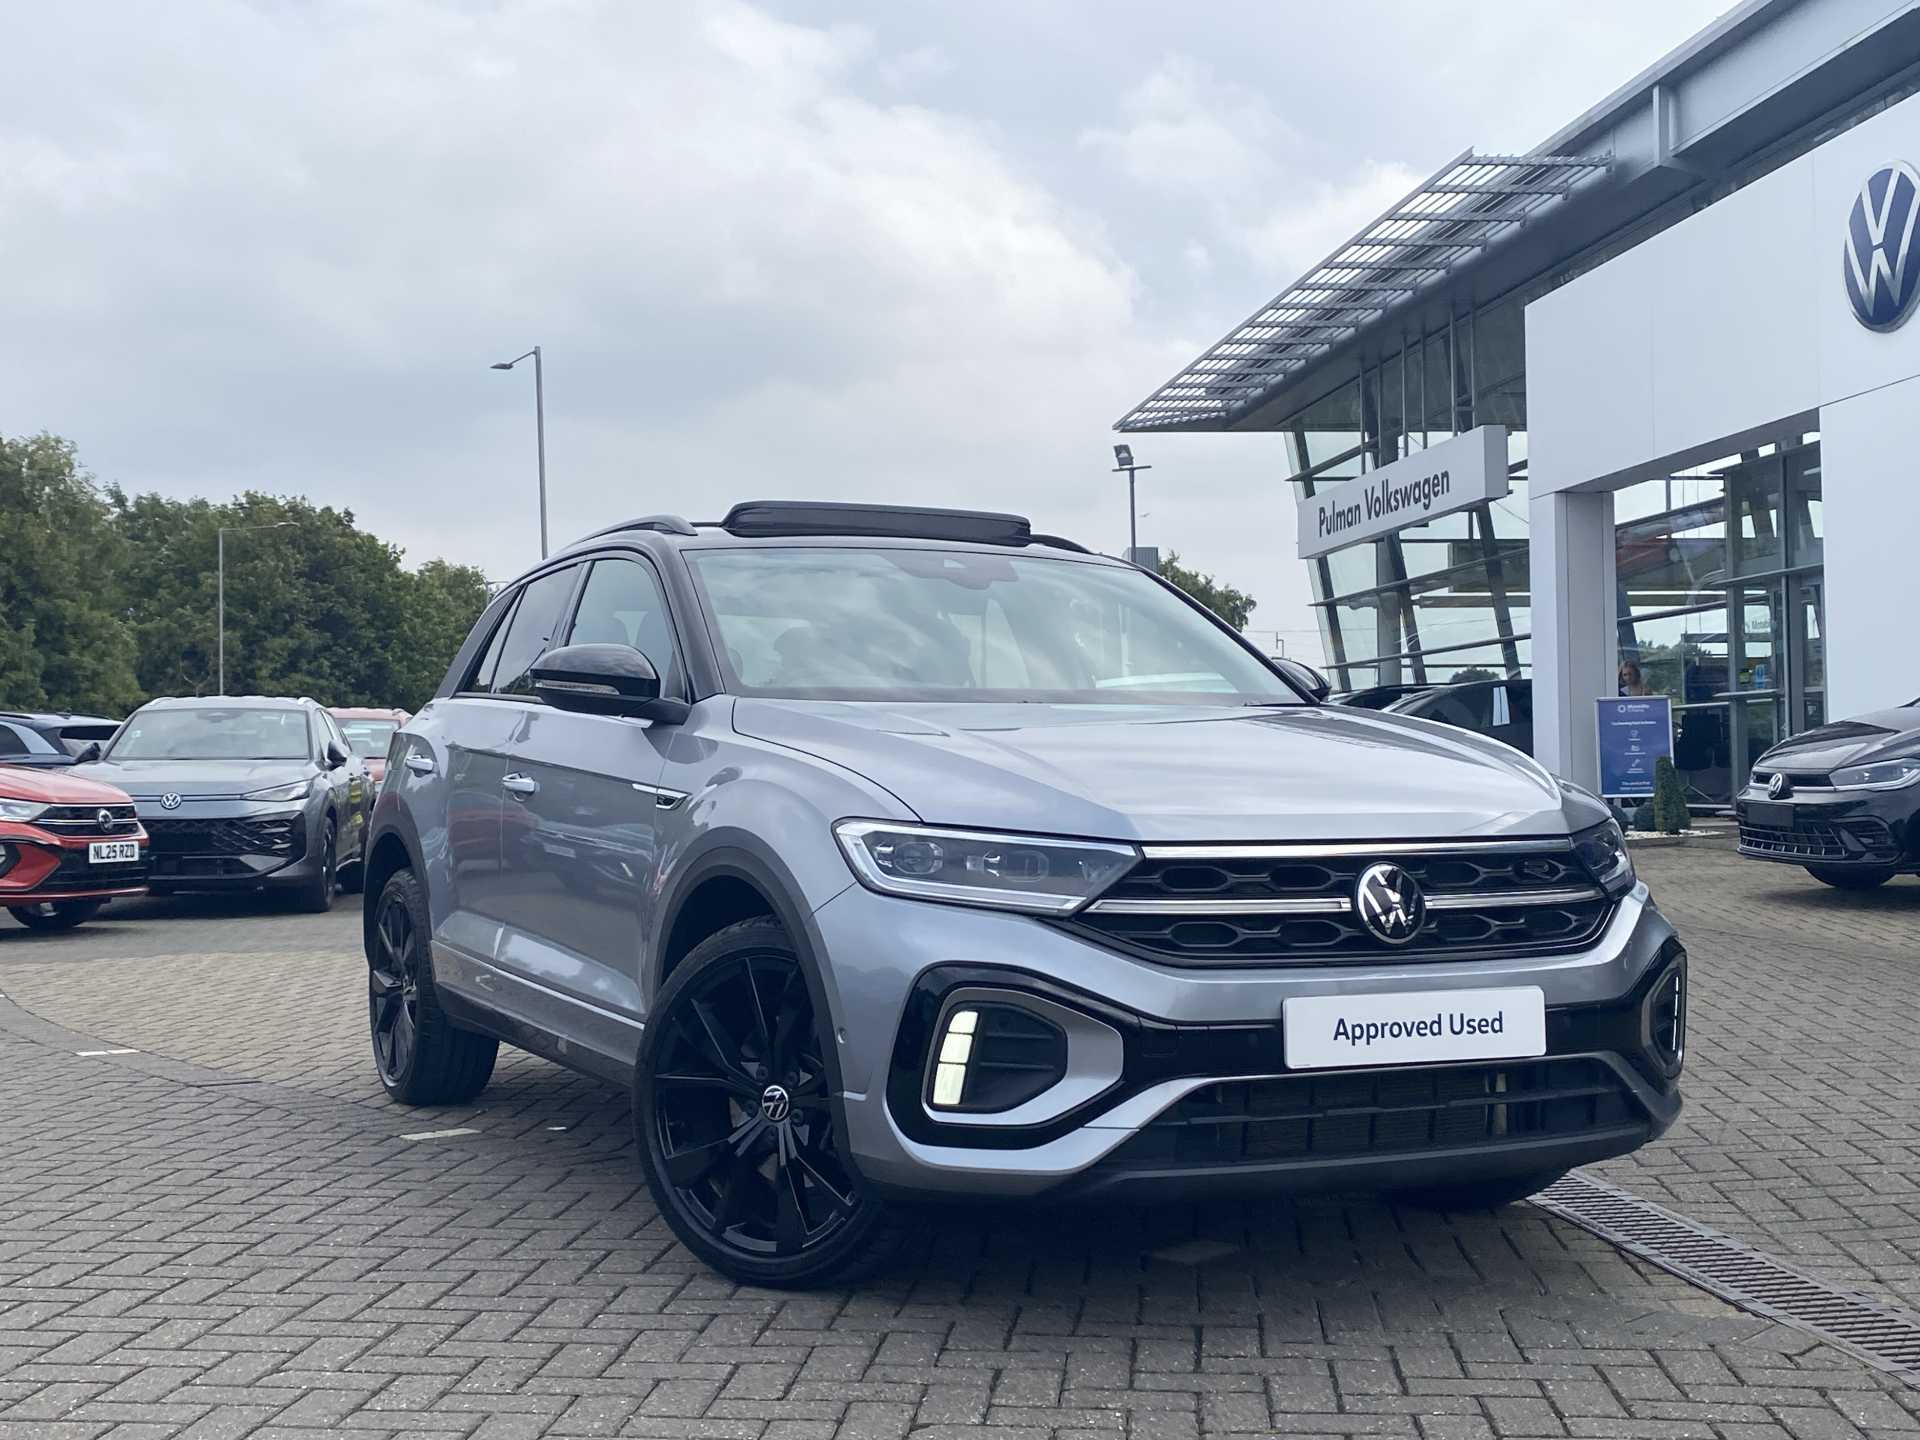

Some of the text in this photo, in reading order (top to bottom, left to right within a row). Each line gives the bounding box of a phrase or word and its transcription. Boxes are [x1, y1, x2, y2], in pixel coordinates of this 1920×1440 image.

[1319, 469, 1450, 537] Pulman Volkswagen
[93, 843, 135, 860] NL25 RZD
[1333, 1011, 1504, 1046] Approved Used
